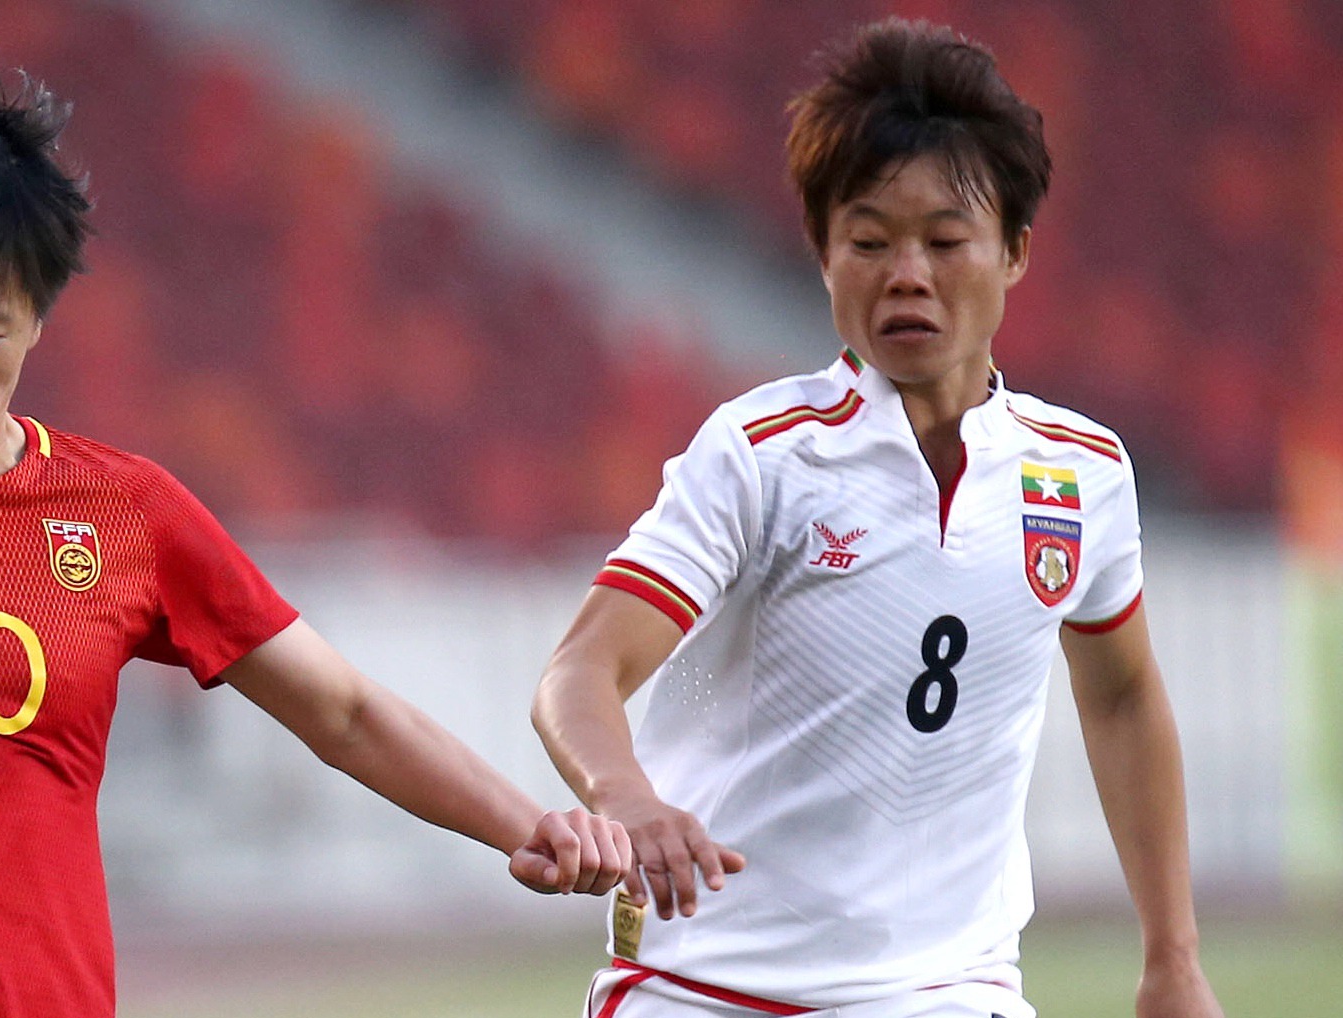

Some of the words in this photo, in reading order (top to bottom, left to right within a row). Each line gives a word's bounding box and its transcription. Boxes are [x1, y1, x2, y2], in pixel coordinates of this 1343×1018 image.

[47, 522, 93, 537] CFA
[809, 551, 860, 569] FBT
[906, 614, 968, 733] 8
